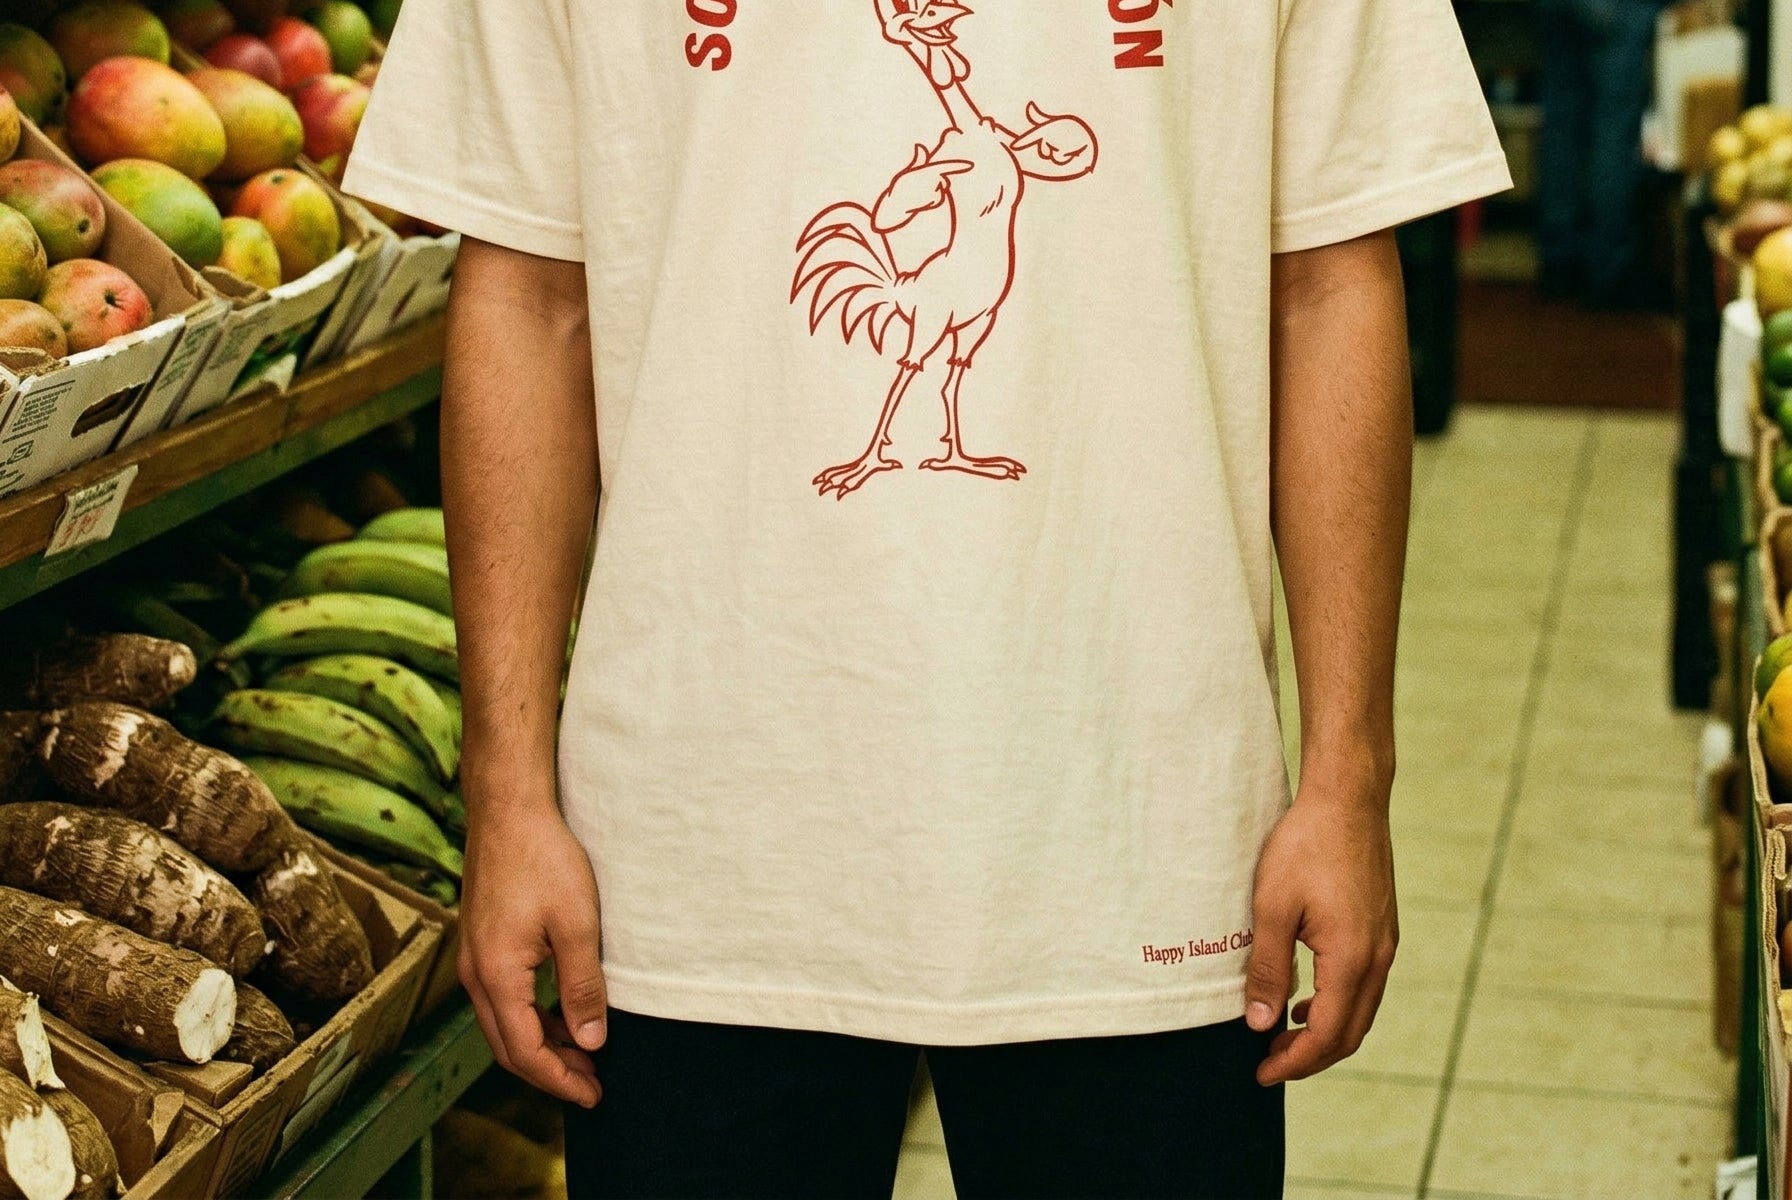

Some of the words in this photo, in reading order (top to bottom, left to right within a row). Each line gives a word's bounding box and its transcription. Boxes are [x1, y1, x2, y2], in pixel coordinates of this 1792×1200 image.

[1142, 944, 1185, 965] Happy
[1188, 936, 1228, 957] Island
[1230, 928, 1254, 950] Club
